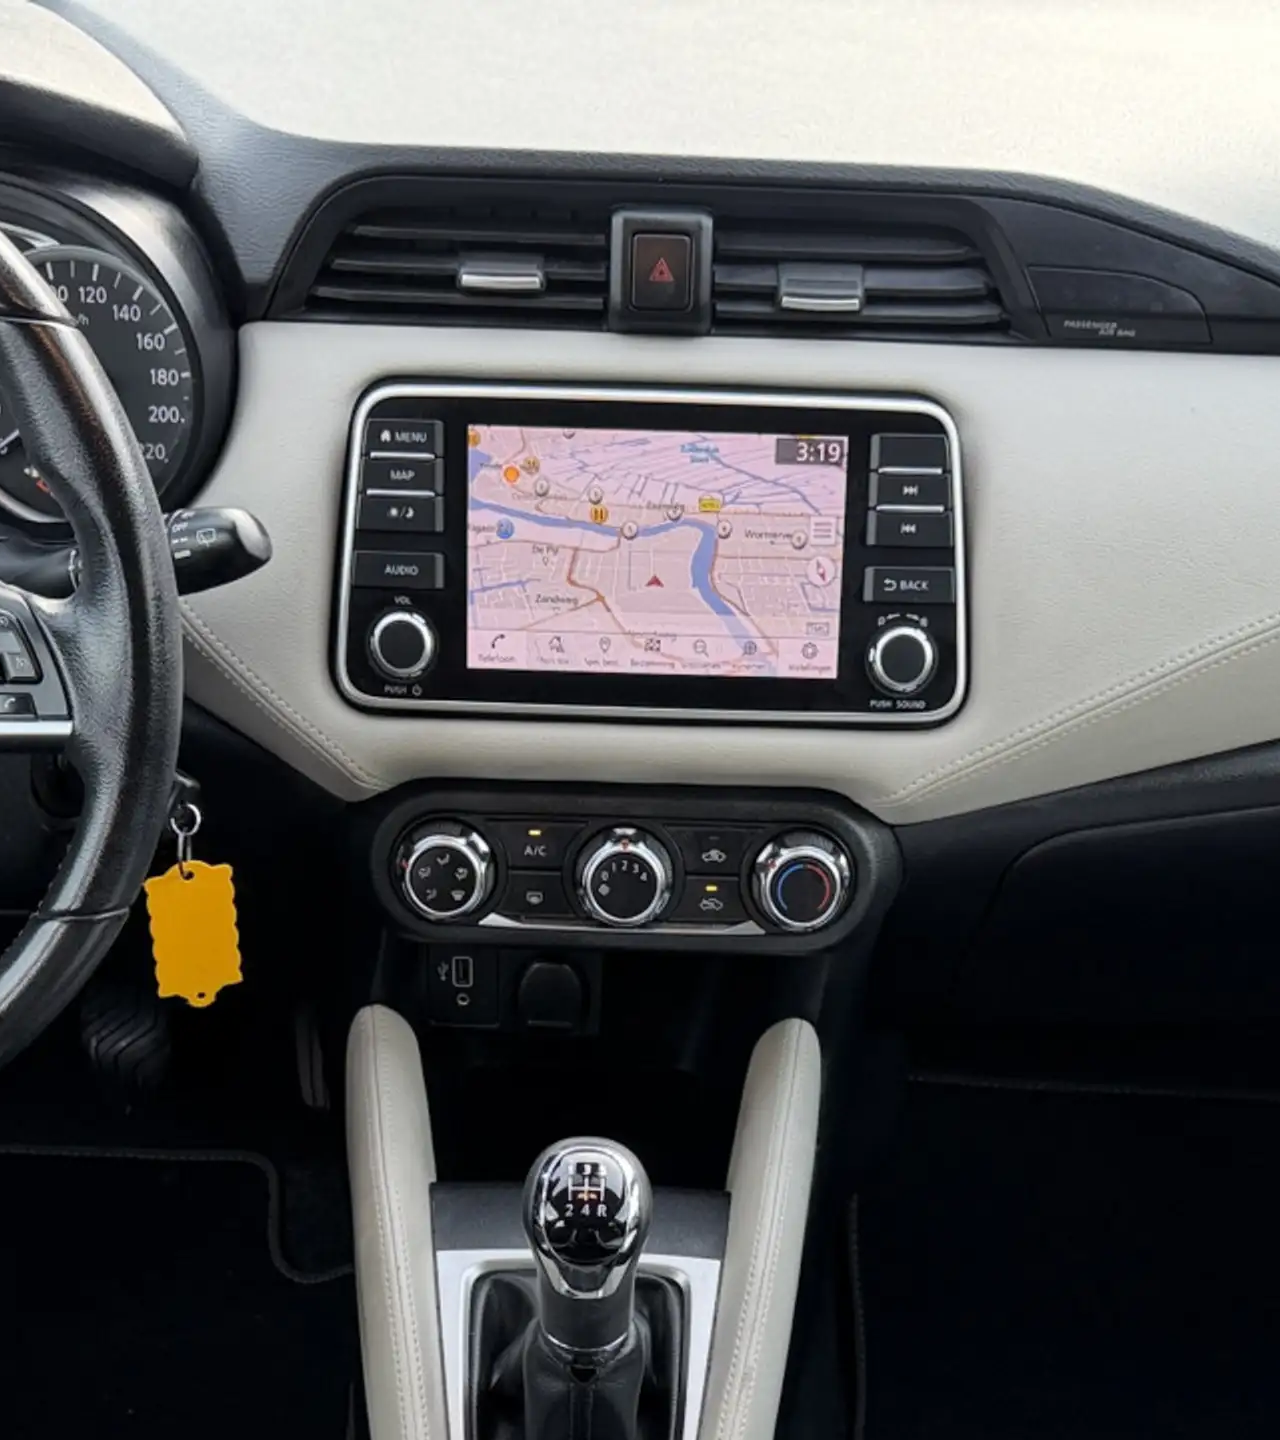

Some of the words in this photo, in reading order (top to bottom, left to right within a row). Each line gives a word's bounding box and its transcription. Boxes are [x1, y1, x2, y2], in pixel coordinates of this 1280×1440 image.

[79, 286, 106, 304] 120
[113, 305, 141, 321] 140
[136, 333, 165, 350] 160
[150, 369, 178, 385] 180
[149, 407, 179, 424] 200
[395, 433, 427, 443] MENU
[796, 441, 841, 462] 3:19
[390, 470, 415, 480] MAP
[384, 565, 418, 575] AUDIO
[900, 580, 929, 591] BACK
[394, 596, 411, 605] VOL
[384, 686, 407, 694] PUSH
[524, 845, 547, 857] A/C
[583, 1164, 592, 1175] 3
[566, 1204, 574, 1217] 2
[580, 1205, 590, 1216] 4
[597, 1205, 607, 1217] R
